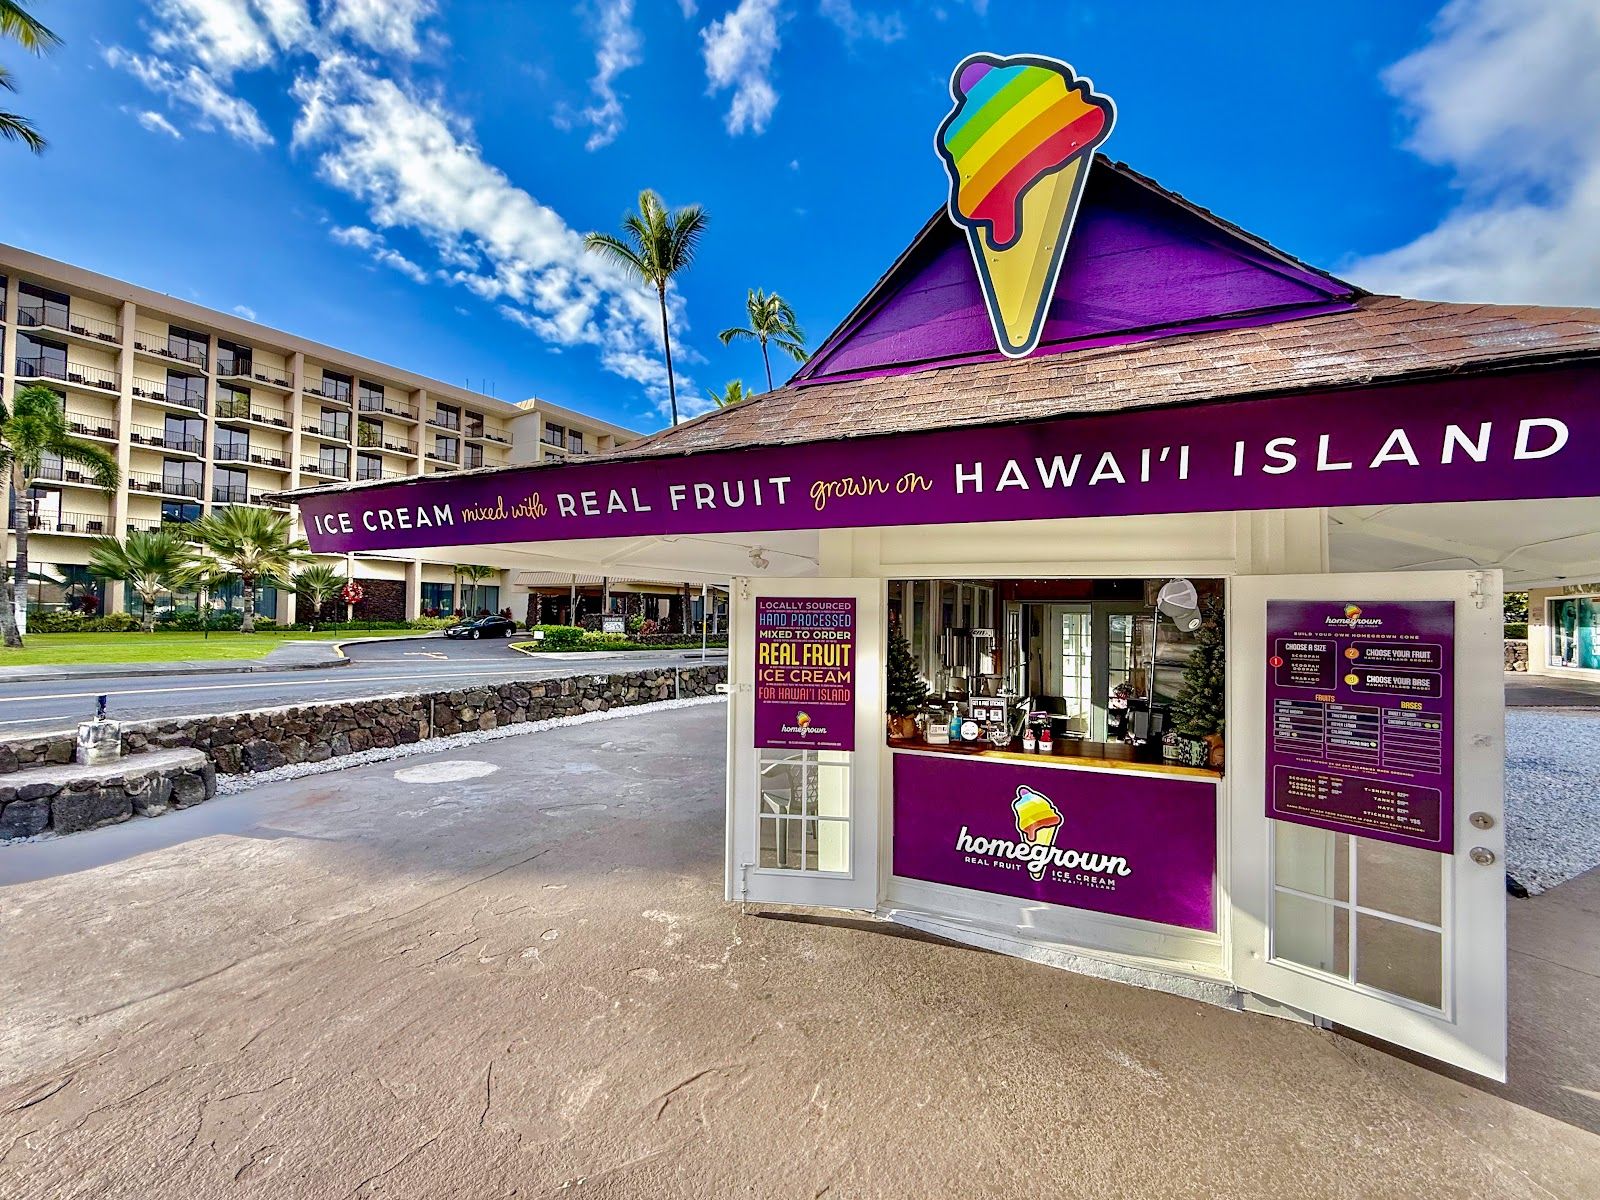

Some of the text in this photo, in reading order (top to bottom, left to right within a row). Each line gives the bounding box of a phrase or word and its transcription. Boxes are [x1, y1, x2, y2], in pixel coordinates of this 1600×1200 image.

[314, 513, 354, 535] ICE
[362, 505, 454, 532] CREAM
[461, 495, 508, 524] mixed
[511, 491, 548, 519] with
[559, 487, 652, 518] REAL
[670, 476, 792, 511] FRUIT
[809, 474, 890, 512] grown
[895, 472, 933, 495] on
[1233, 417, 1570, 477] ISLAND
[760, 601, 851, 610] LOCALLY SOURCED
[760, 613, 851, 627] HAND PROCESSED
[1326, 616, 1383, 627] homegrown
[760, 630, 851, 639] MIXED TO ORDER
[1285, 643, 1308, 651] CHOOSE
[1314, 644, 1327, 652] SIZE
[759, 643, 851, 666] REAL FRUIT
[1366, 649, 1431, 659] CHOOSE YOUR FRUIT
[759, 669, 851, 683] ICE CREAM
[1366, 675, 1430, 687] CHOOSE YOUR BASE
[759, 687, 776, 699] FOR
[818, 689, 850, 701] ISLAND
[1401, 701, 1422, 710] BASES
[781, 724, 827, 737] homegrown
[1364, 787, 1394, 796] T-SHIRTS
[1363, 810, 1394, 819] STICKERS
[956, 826, 1131, 876] homegrown
[965, 857, 1021, 871] REAL FRUIT
[1052, 870, 1115, 886] ICE CREAM
[1087, 882, 1115, 890] ISLAND
